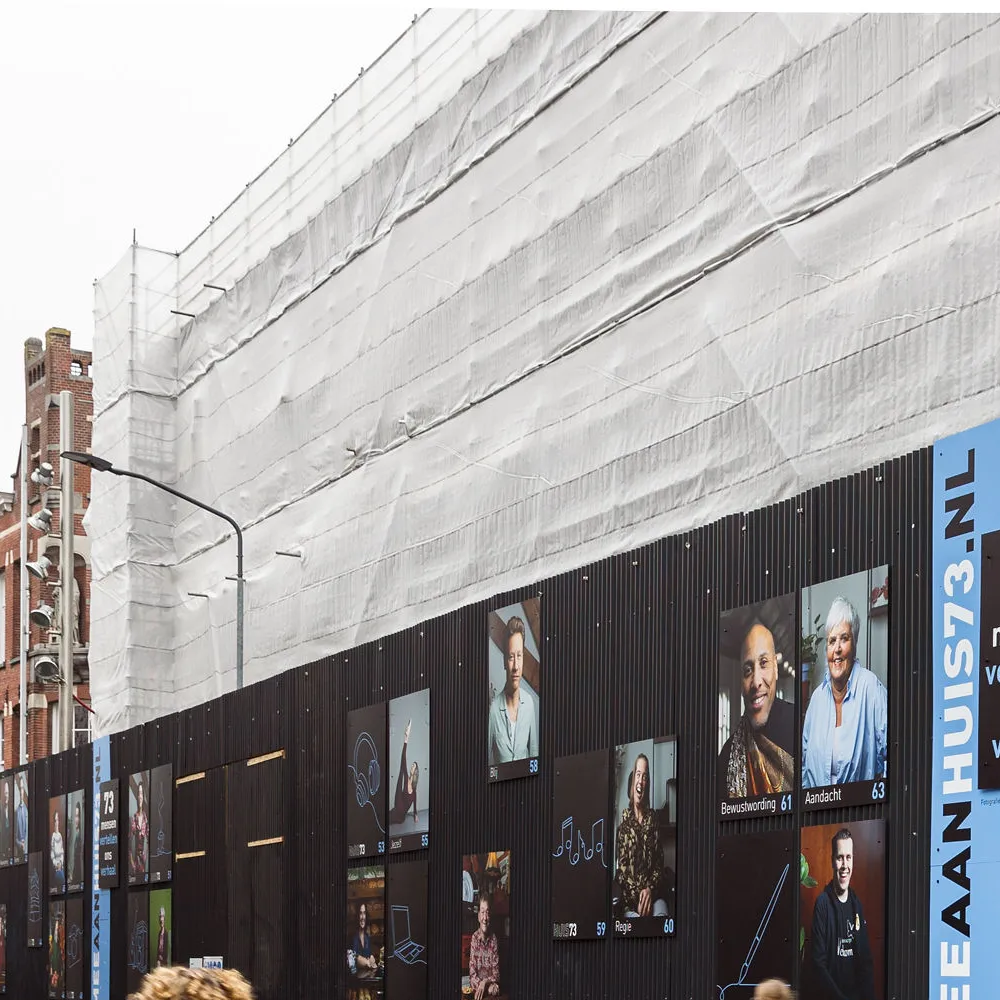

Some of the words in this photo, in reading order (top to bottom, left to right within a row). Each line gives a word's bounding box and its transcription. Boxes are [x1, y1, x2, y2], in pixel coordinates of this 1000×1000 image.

[529, 759, 538, 773] 58
[104, 790, 114, 814] 73
[805, 788, 842, 804] Aandacht
[871, 782, 885, 799] 63
[721, 798, 776, 815] Bewustwording
[780, 794, 792, 811] 61
[596, 922, 606, 936] 59
[615, 920, 632, 935] Regie
[663, 919, 674, 934] 60
